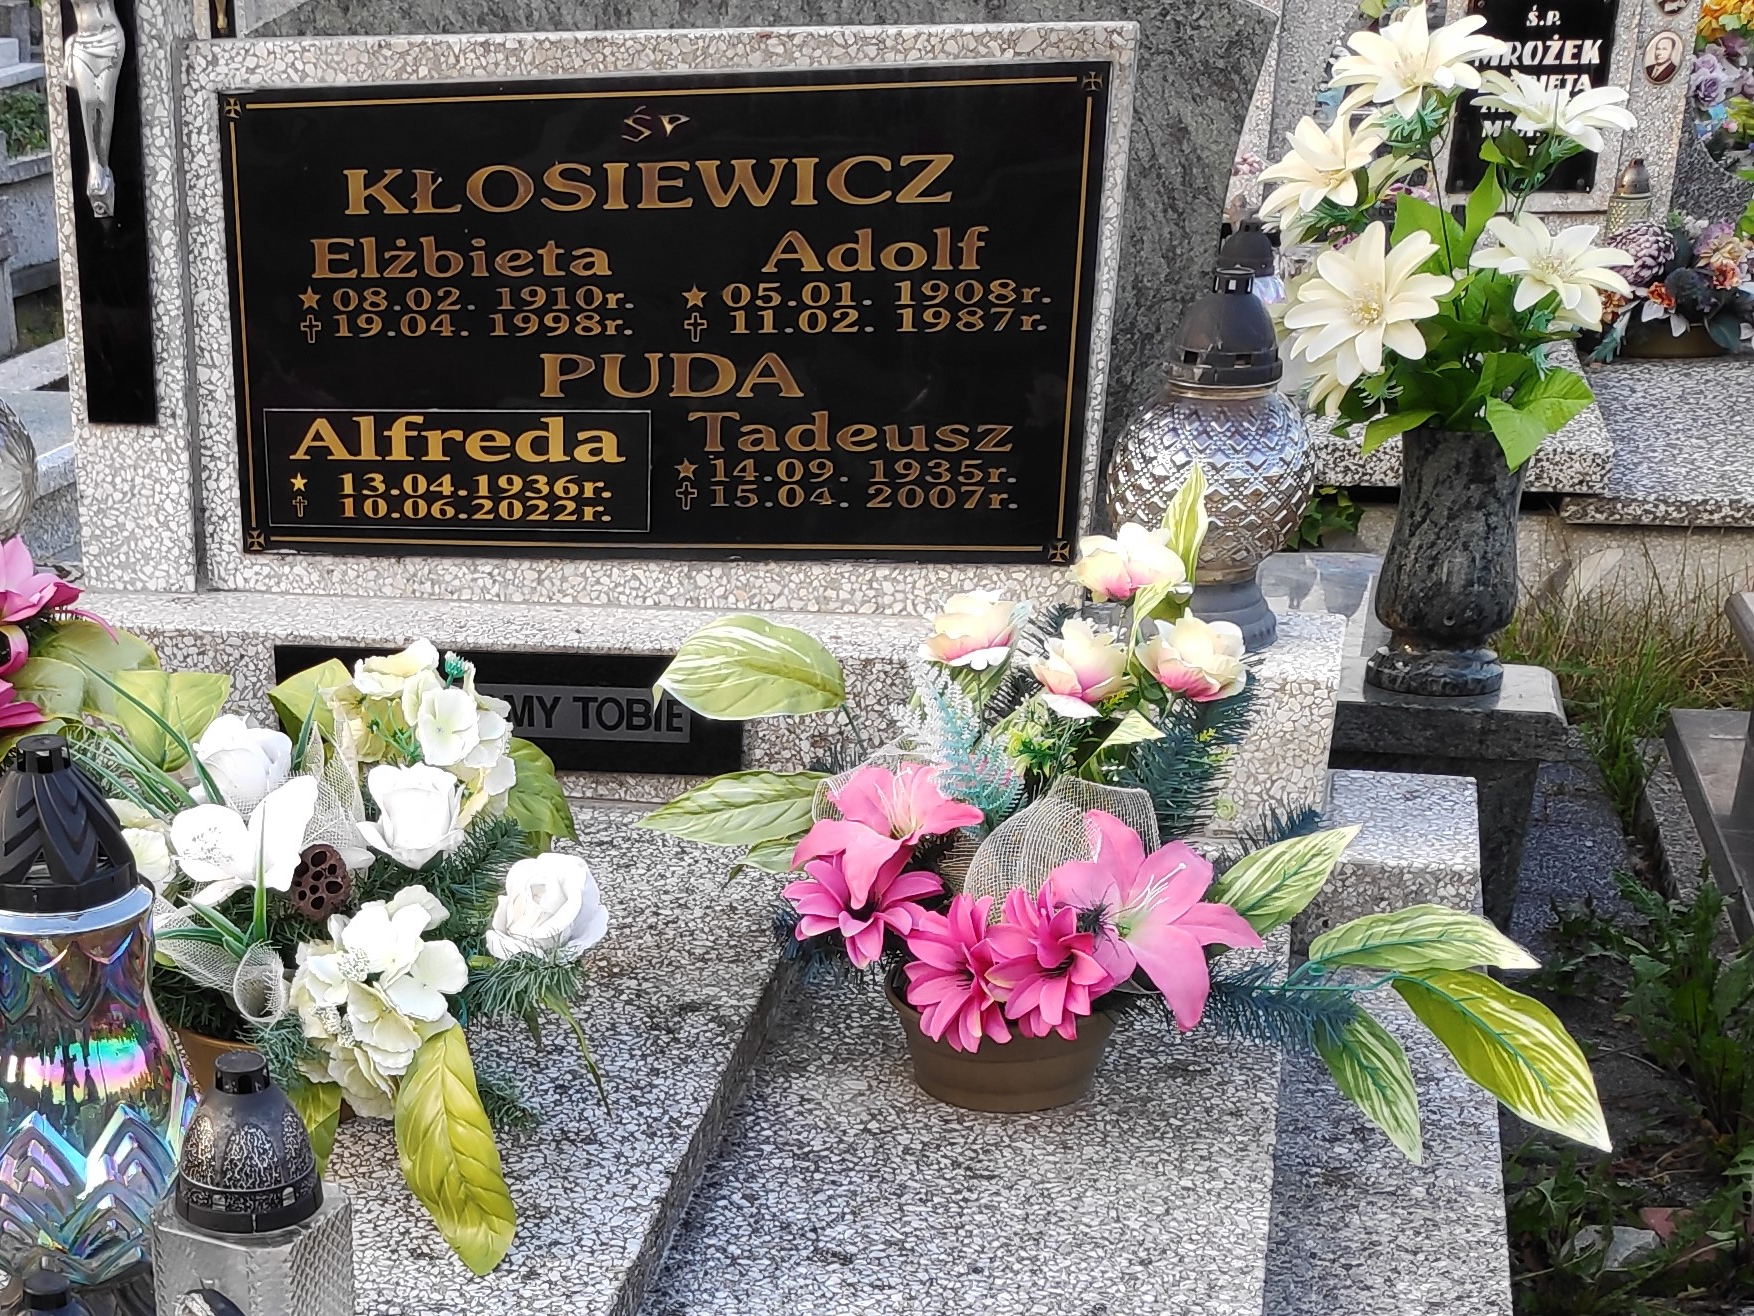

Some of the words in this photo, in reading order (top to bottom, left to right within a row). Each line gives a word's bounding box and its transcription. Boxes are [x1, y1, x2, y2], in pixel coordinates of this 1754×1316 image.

[342, 154, 954, 215] KŁOSIEWICZ
[310, 236, 613, 279] Elżbieta
[761, 225, 990, 273] Adolf
[332, 286, 476, 312] 08.02.
[495, 284, 635, 310] 1910r.
[721, 281, 873, 308] 05.01.
[893, 279, 1052, 305] 1908r.
[332, 313, 470, 338] 19.04.
[489, 312, 634, 336] 1998r.
[729, 308, 875, 334] 11.02.
[895, 307, 1048, 333] 1987r.
[539, 352, 805, 399] PUDA
[288, 415, 627, 463] Alfreda
[687, 411, 1015, 453] Tadeusz
[708, 457, 849, 483] 14.09.
[868, 458, 1017, 483] 1935r.
[338, 472, 613, 499] 13.04.1936r.
[709, 484, 850, 508] 15.04.
[866, 484, 1019, 509] 2007r.
[340, 497, 613, 523] 10.06.2022r.
[572, 696, 684, 733] TOBIE
